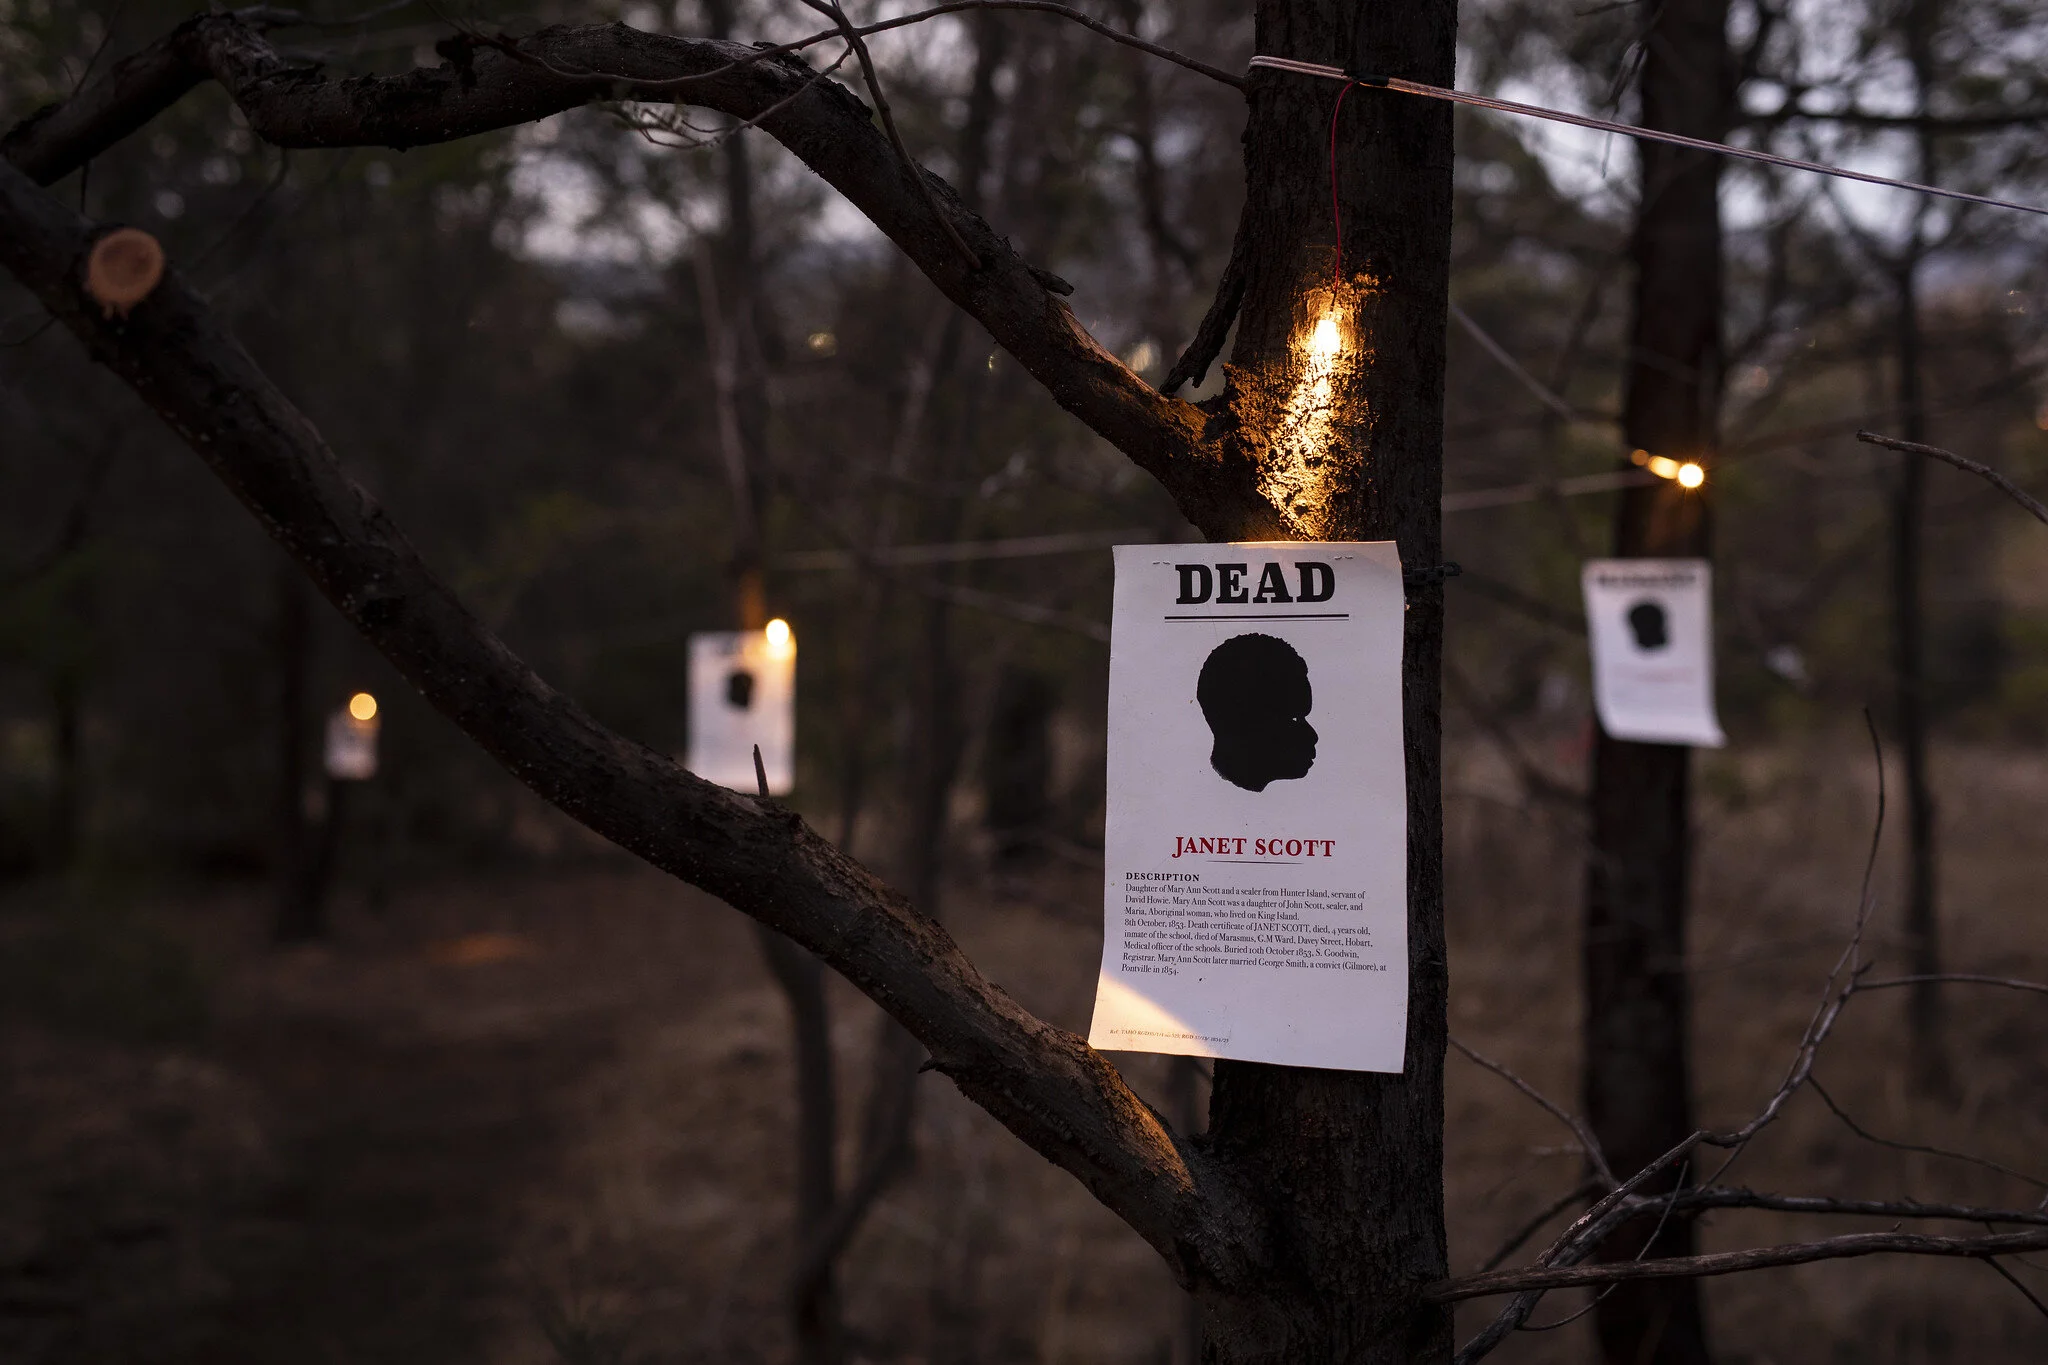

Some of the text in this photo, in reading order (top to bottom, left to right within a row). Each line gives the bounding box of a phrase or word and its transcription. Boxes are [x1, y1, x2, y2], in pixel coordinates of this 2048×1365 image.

[1175, 561, 1336, 605] DEAD
[1172, 836, 1336, 858] JANET SCOTT
[1126, 872, 1200, 881] DESCRIPTION
[1126, 884, 1158, 893] Daughter
[1159, 885, 1167, 893] of
[1167, 885, 1185, 895] Mary
[1203, 886, 1220, 894] Scott
[1241, 888, 1261, 896] sealer
[1263, 888, 1278, 896] from
[1280, 888, 1305, 897] Hunter
[1358, 891, 1366, 899] of
[1125, 895, 1145, 904] David
[1173, 897, 1190, 907] Mary
[1208, 898, 1225, 906] Scott
[1246, 899, 1277, 909] daughter
[1278, 900, 1286, 908] of
[1286, 900, 1303, 909] John
[1350, 903, 1363, 911] and
[1148, 908, 1184, 918] Aboriginal
[1214, 910, 1228, 918] who
[1230, 910, 1245, 918] lived
[1258, 911, 1275, 921] King
[1188, 921, 1208, 929] Death
[1210, 922, 1244, 930] certificate
[1246, 923, 1252, 931] of
[1253, 923, 1281, 931] JANET
[1338, 927, 1356, 936] years
[1125, 930, 1147, 938] inmate
[1298, 936, 1319, 946] Davey
[1124, 941, 1150, 949] Medical
[1152, 942, 1173, 950] officer
[1175, 943, 1182, 951] of
[1225, 945, 1247, 953] Buried
[1249, 946, 1264, 954] 10th
[1266, 947, 1294, 955] October
[1122, 964, 1151, 972] Pontville
[1153, 965, 1159, 973] in
[1158, 954, 1175, 964] Mary
[1177, 955, 1191, 963] Ann
[1212, 956, 1228, 964] later
[1230, 957, 1256, 966] married
[1259, 958, 1284, 968] George
